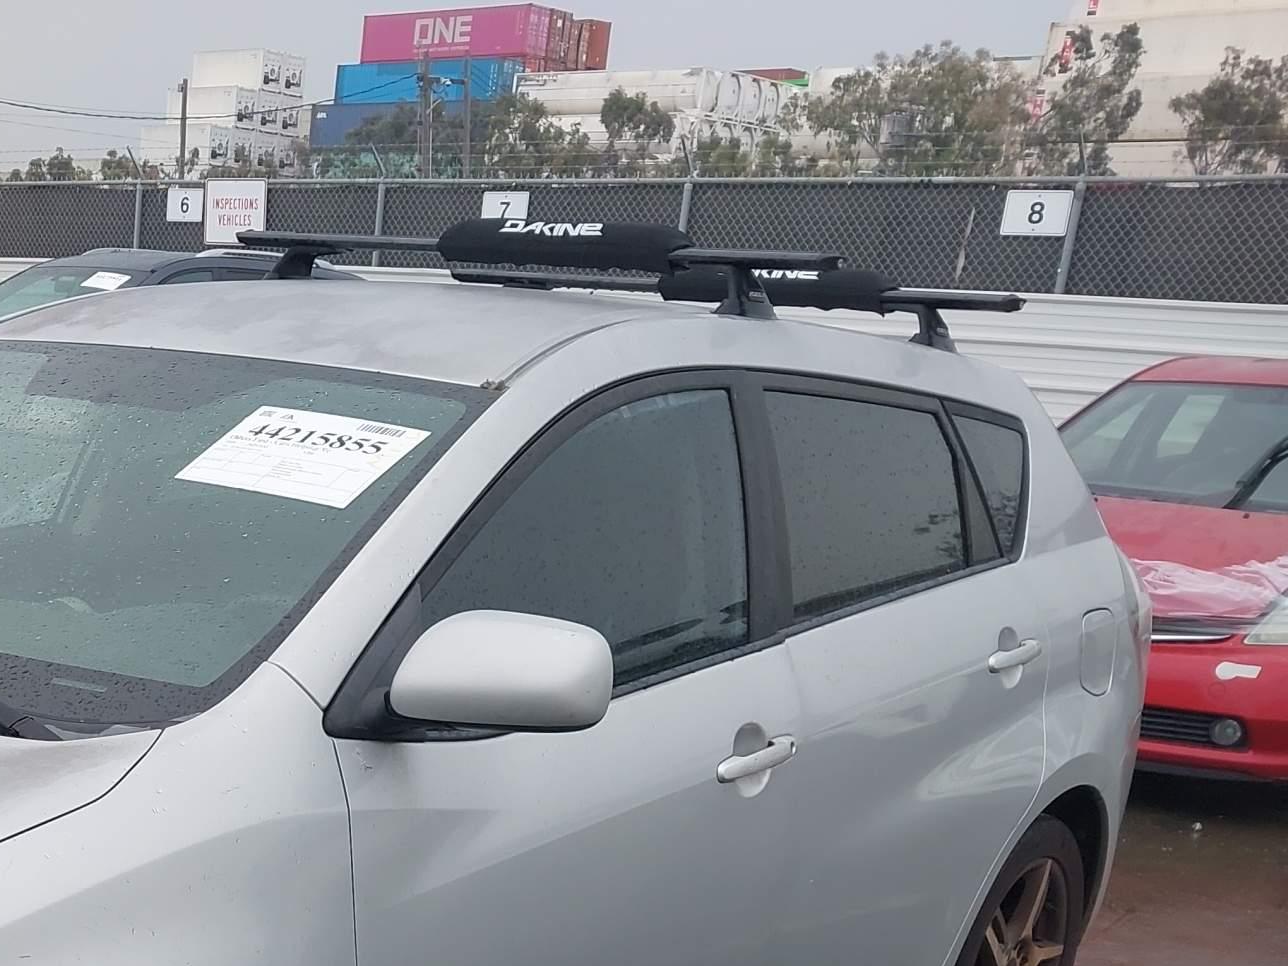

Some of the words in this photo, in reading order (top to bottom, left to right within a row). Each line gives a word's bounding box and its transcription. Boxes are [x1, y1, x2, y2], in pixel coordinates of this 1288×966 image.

[414, 15, 472, 45] ONE
[180, 196, 190, 213] 6
[213, 198, 259, 210] INSPECTIONS
[499, 201, 511, 219] 7
[1028, 201, 1045, 224] 8
[218, 214, 252, 226] VEHICLES
[498, 220, 603, 236] DAKINE
[249, 423, 388, 455] 44215855
